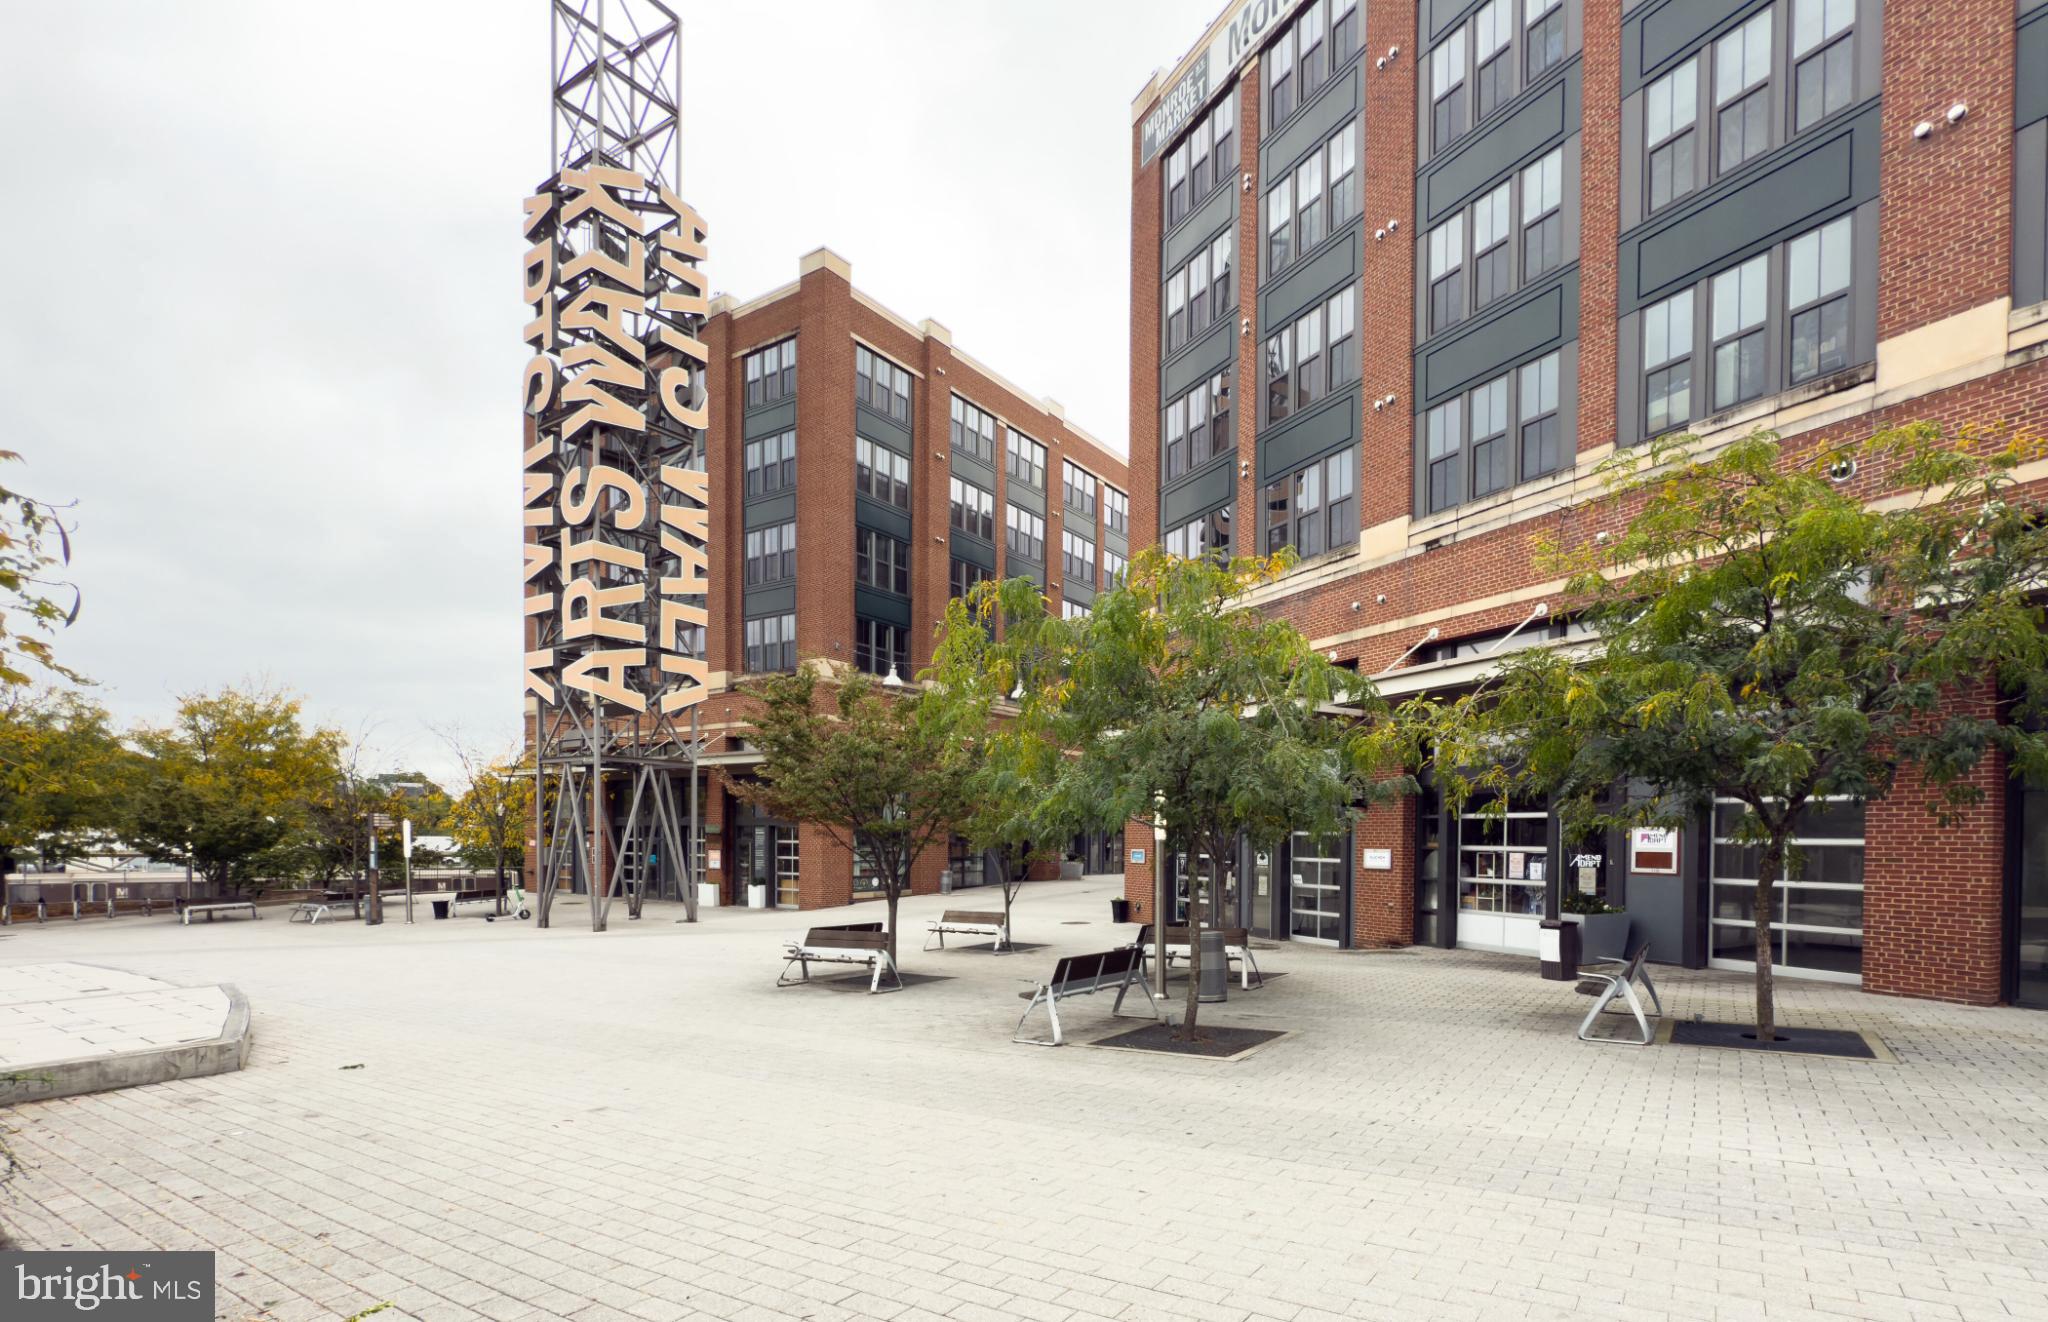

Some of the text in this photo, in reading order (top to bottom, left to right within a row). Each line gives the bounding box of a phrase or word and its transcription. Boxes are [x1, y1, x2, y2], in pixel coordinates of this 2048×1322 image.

[1144, 67, 1199, 142] MONROE
[1155, 78, 1206, 147] MARKET
[560, 164, 646, 713] ARTS WALK
